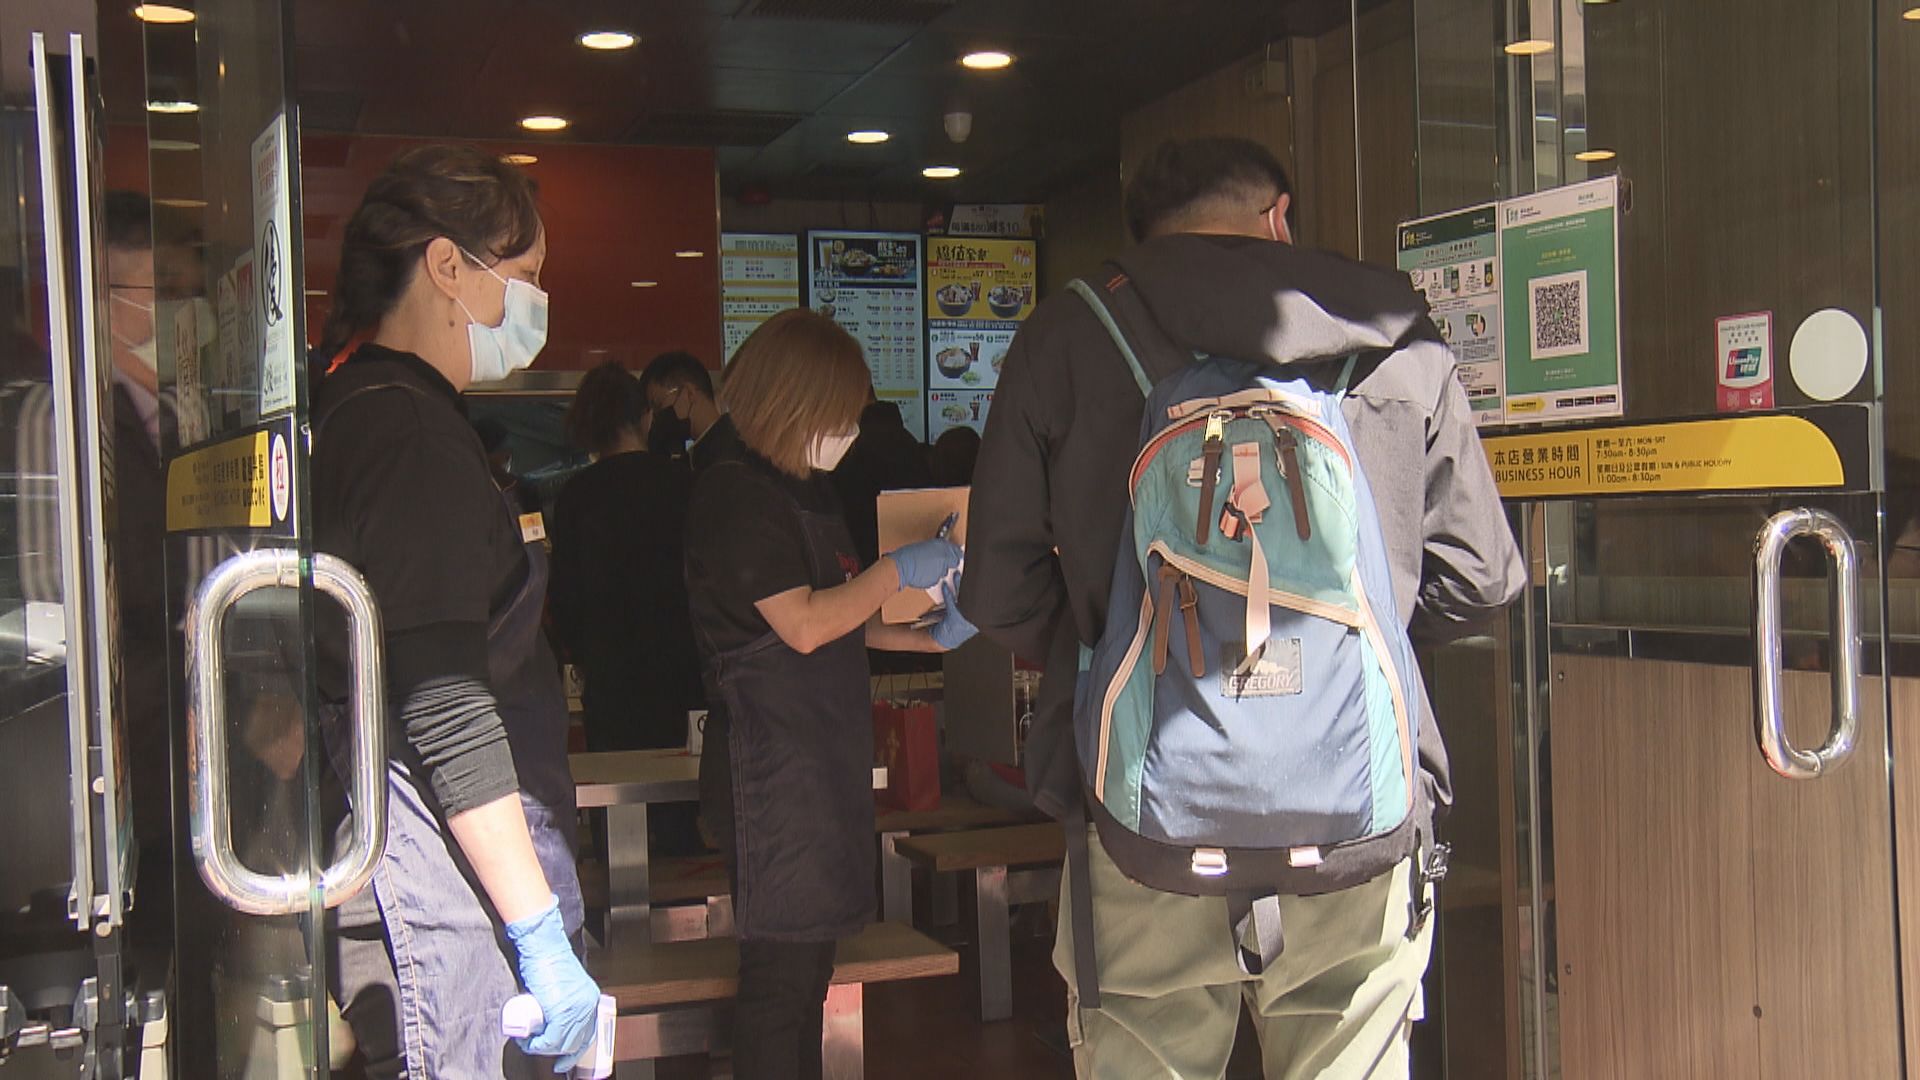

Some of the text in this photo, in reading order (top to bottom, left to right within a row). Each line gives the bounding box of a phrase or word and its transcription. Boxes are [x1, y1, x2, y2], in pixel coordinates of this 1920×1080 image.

[1494, 444, 1580, 466] 本店營業時間
[1495, 465, 1581, 483] BUSINESS HOUR
